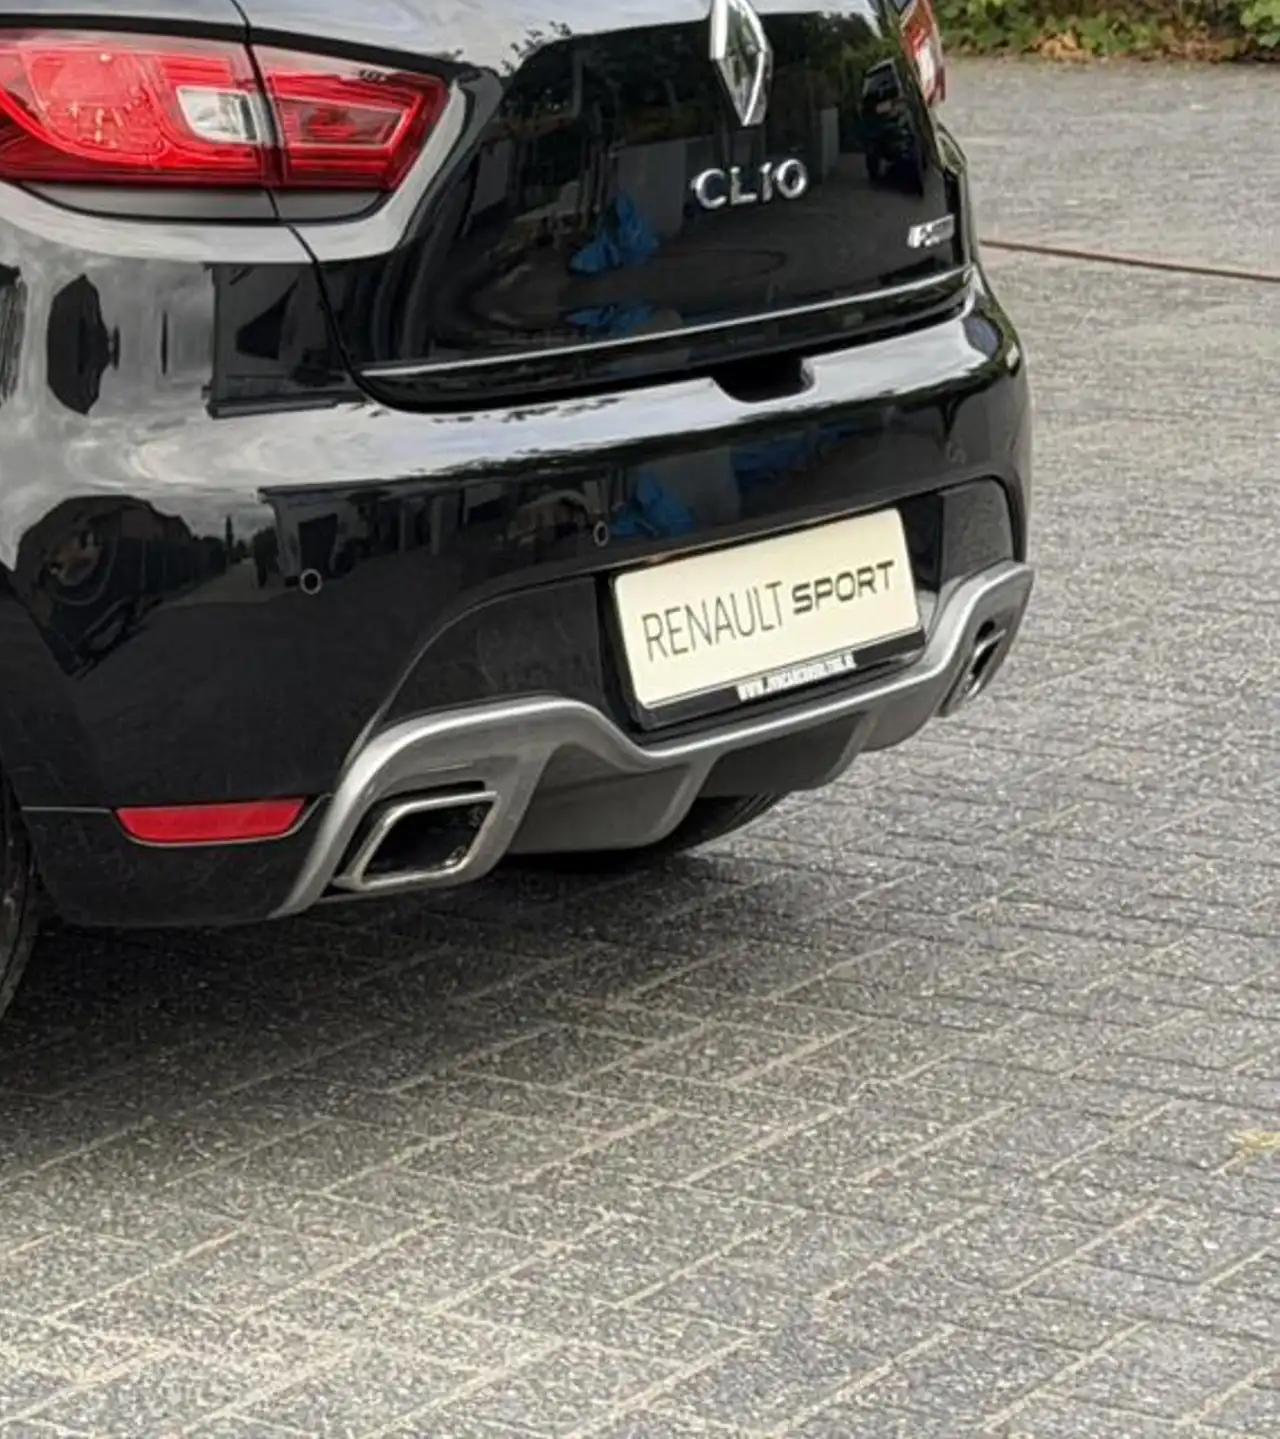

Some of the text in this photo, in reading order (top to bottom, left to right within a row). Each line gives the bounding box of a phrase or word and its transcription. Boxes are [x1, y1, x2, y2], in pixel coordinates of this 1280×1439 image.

[690, 158, 808, 210] CLIO
[641, 560, 895, 662] RENAULT SPORT
